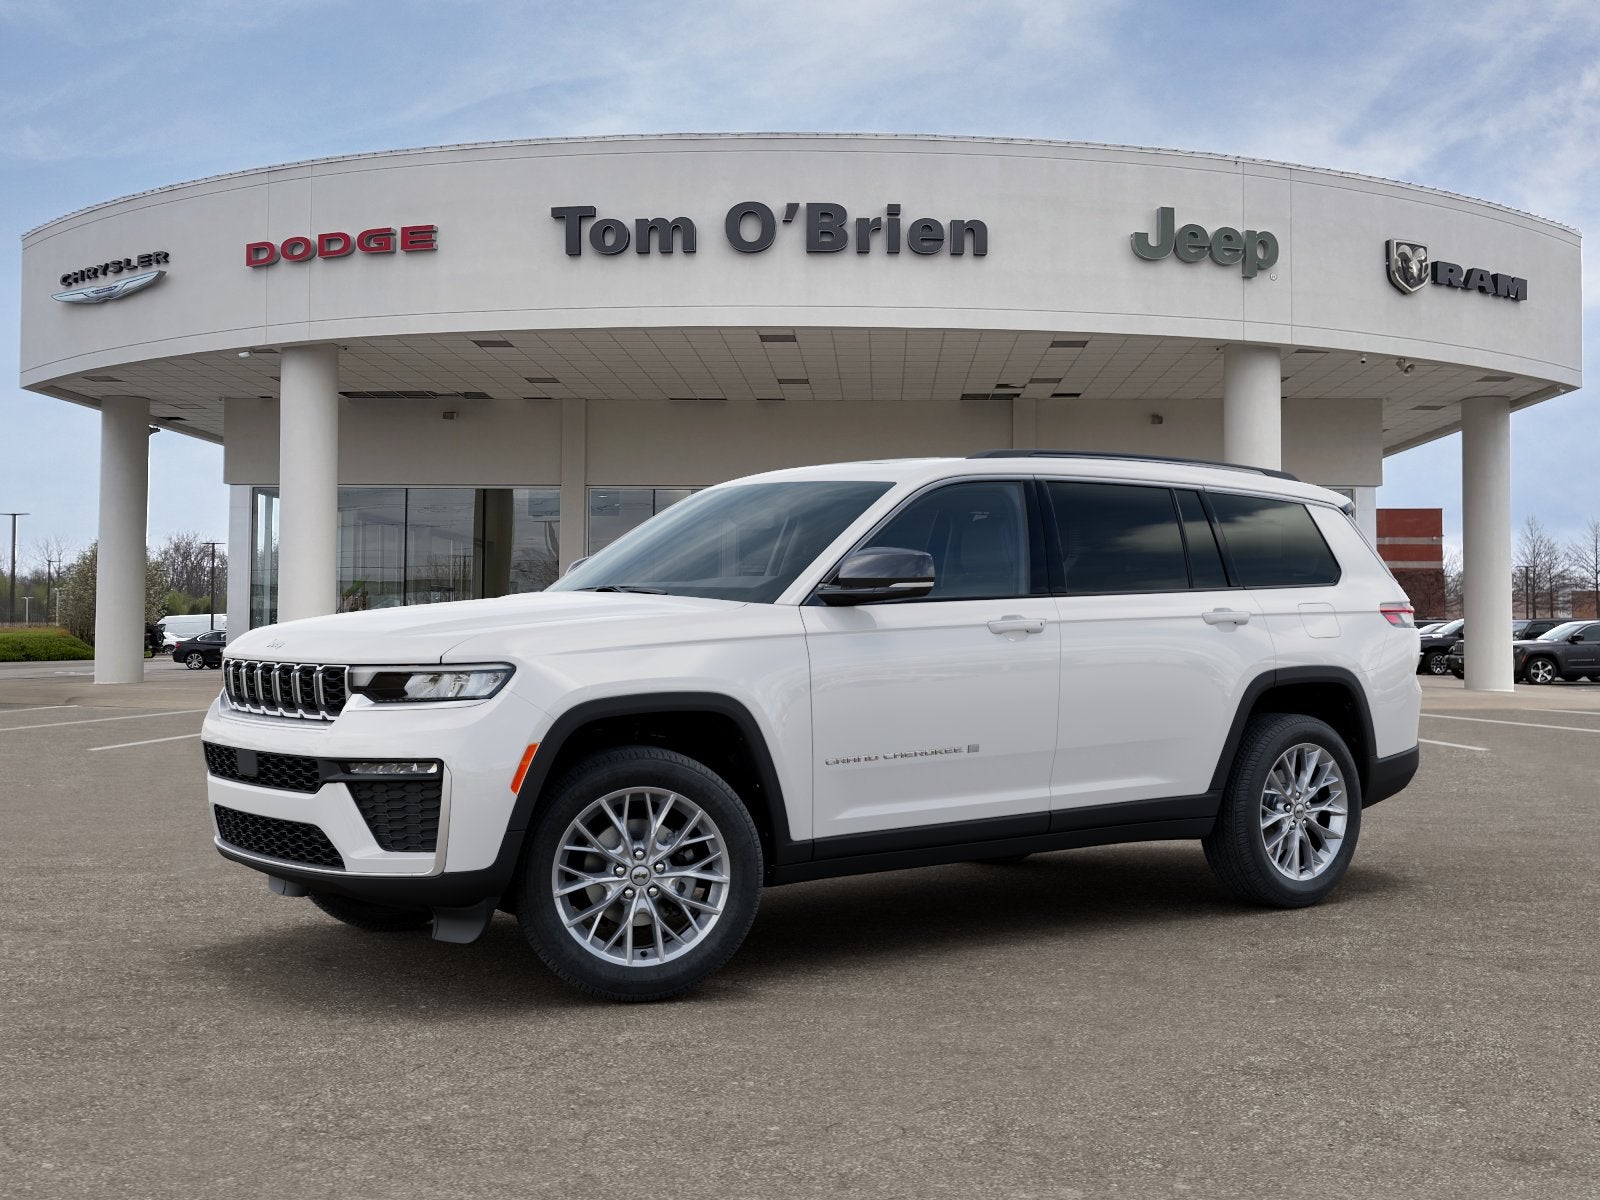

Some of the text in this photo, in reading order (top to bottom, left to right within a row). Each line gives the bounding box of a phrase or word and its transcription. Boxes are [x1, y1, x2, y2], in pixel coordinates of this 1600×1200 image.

[245, 224, 438, 268] DODGE
[551, 201, 988, 256] Tom O'Brien
[1130, 207, 1279, 279] Jeep
[60, 250, 170, 286] CHRYSLER
[1430, 260, 1528, 301] RAM
